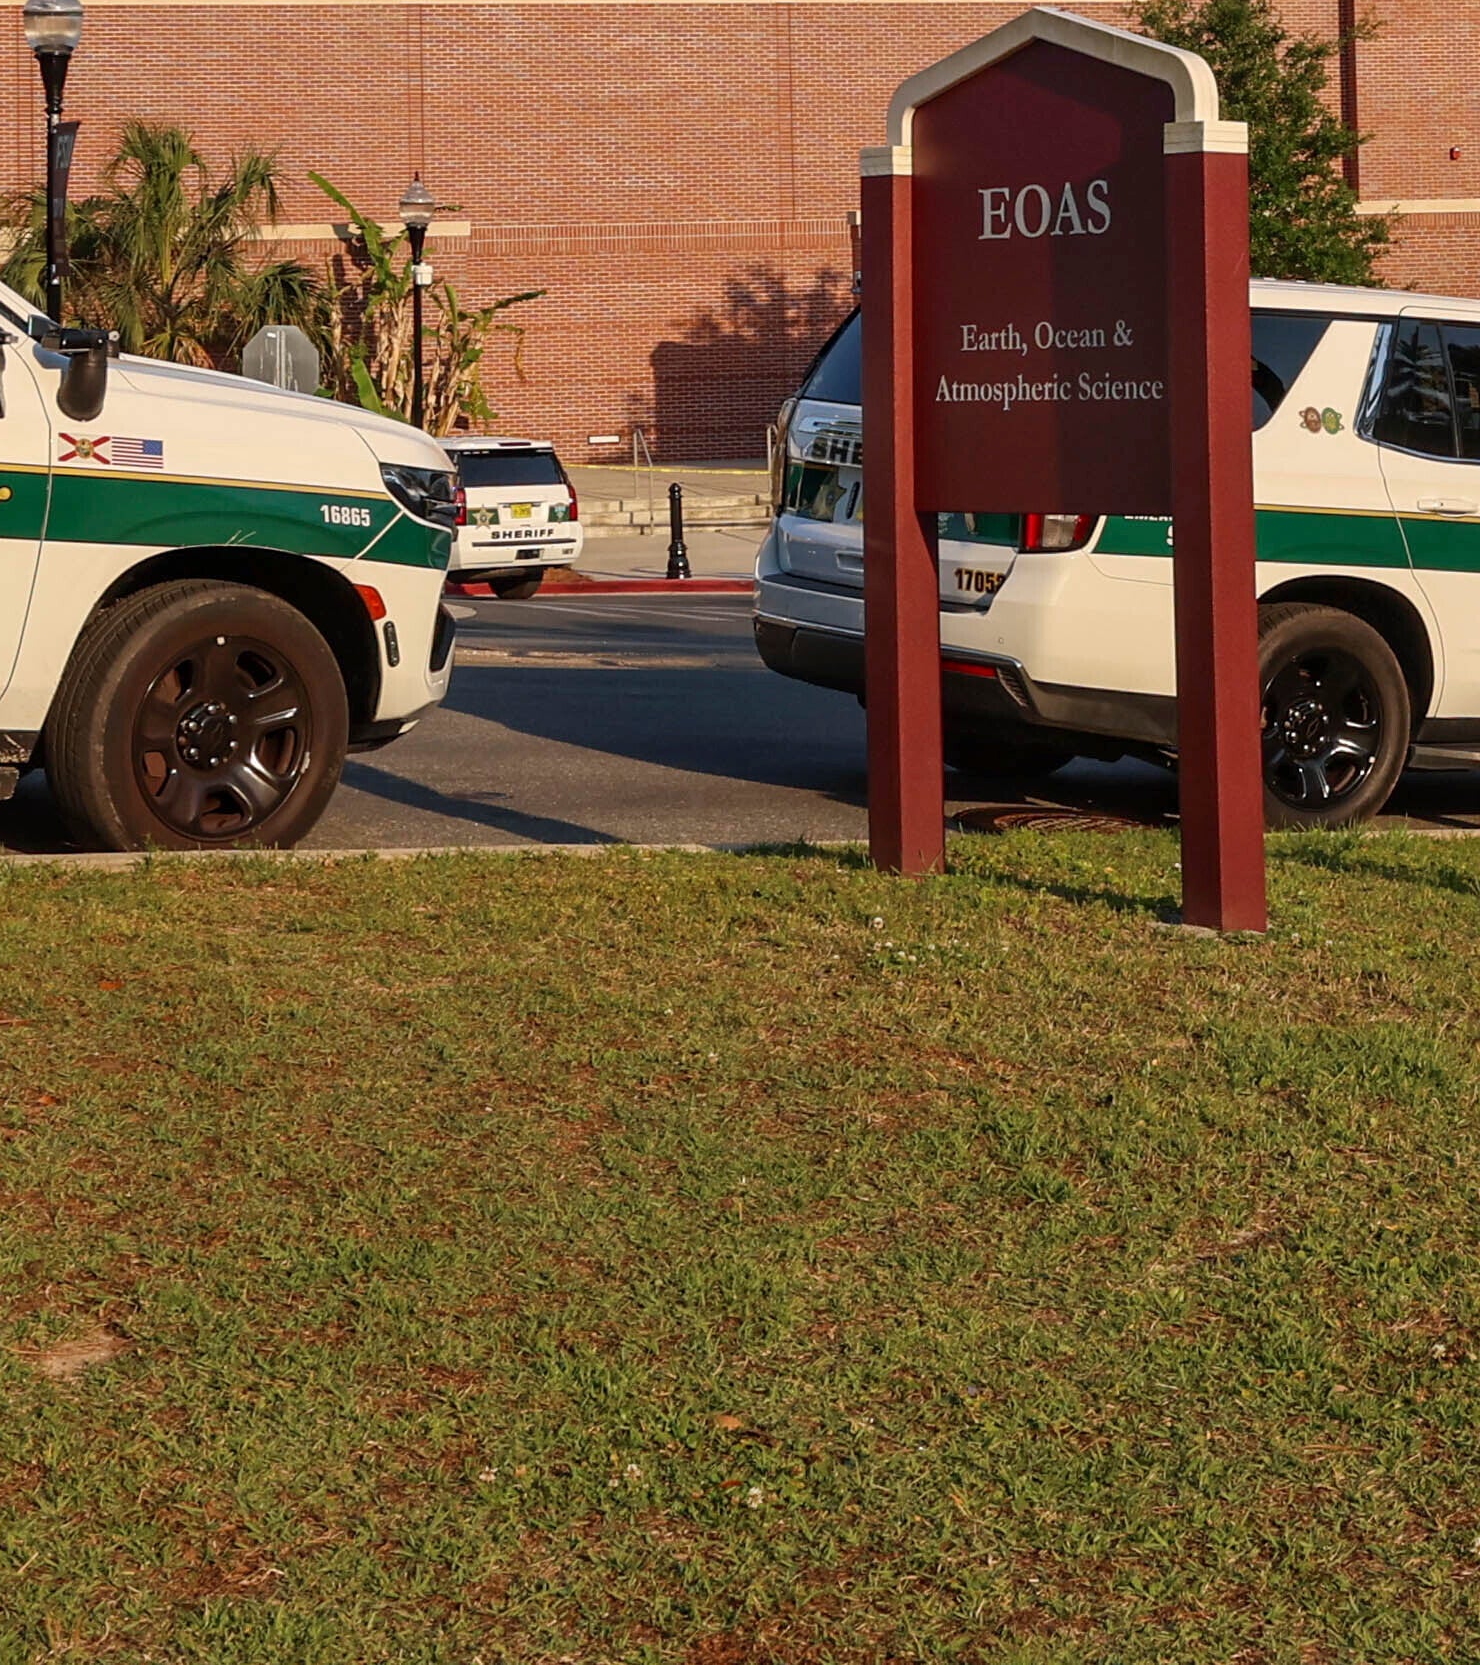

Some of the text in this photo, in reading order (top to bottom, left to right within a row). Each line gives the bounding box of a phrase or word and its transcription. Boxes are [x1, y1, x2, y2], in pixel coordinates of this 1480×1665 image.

[978, 179, 1112, 240] EOAS
[960, 319, 1134, 357] Earth, Ocean &
[936, 372, 1163, 411] Atmospheric Science
[320, 504, 370, 527] 16865
[491, 528, 555, 540] SHERIFF
